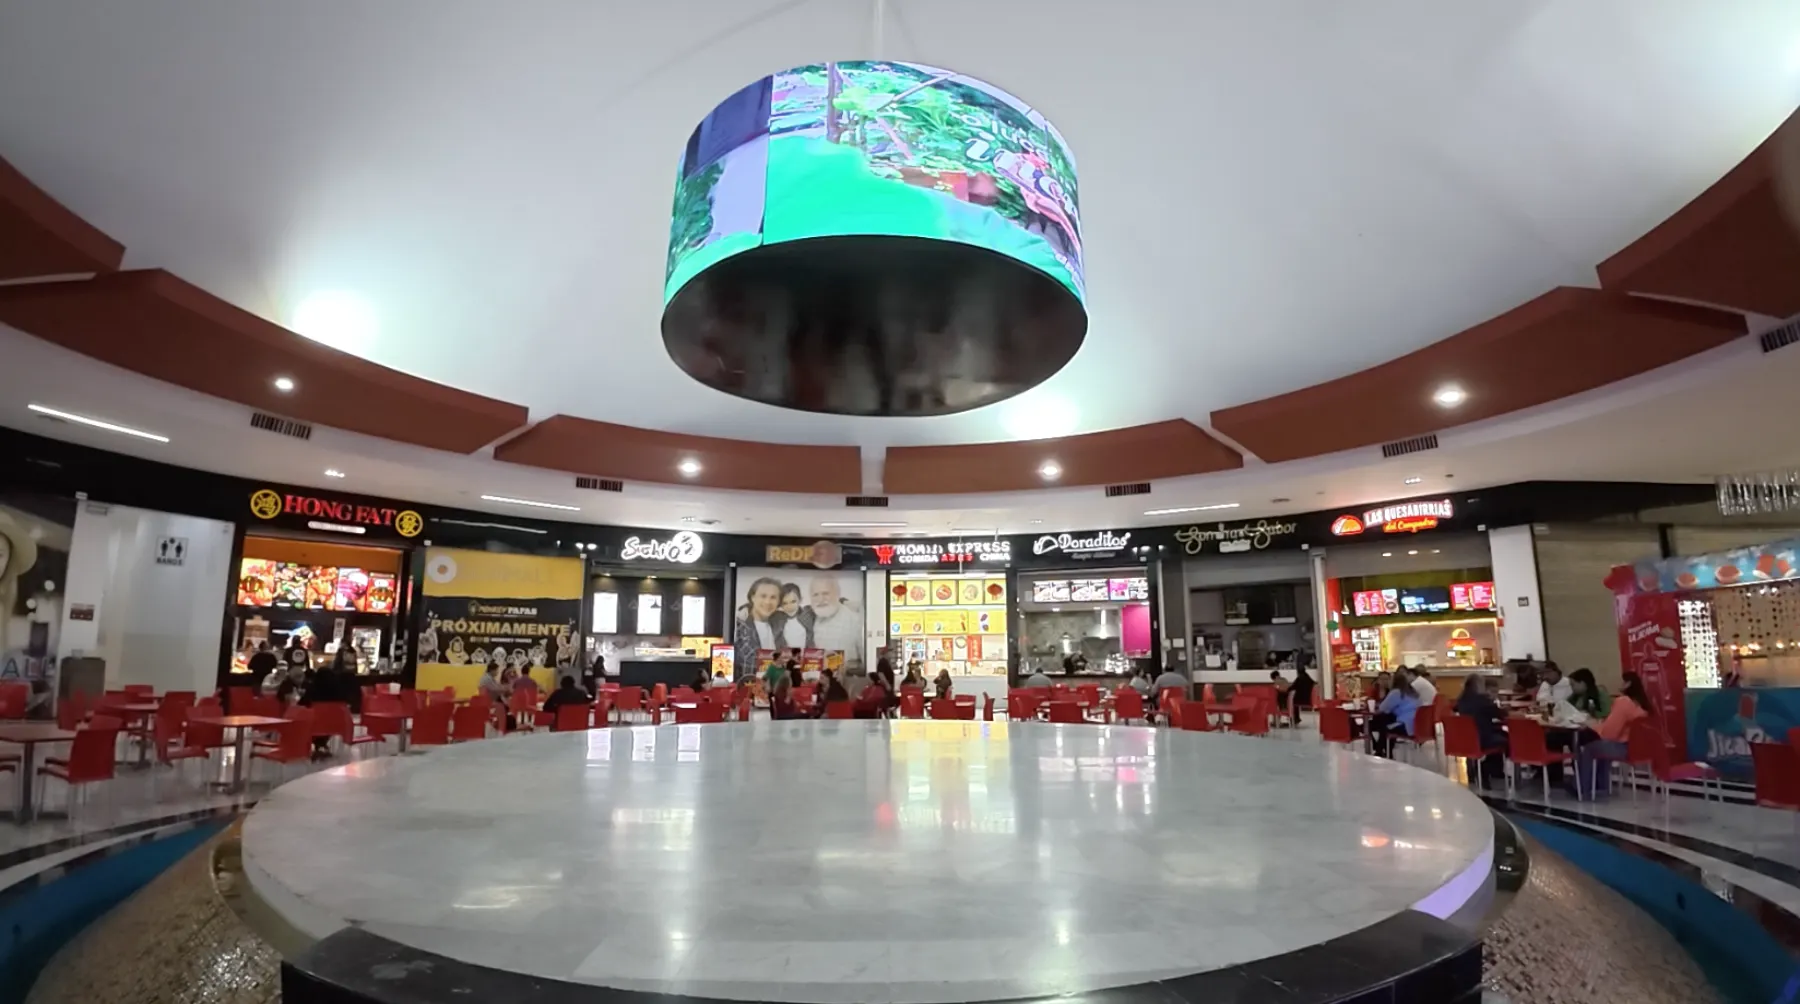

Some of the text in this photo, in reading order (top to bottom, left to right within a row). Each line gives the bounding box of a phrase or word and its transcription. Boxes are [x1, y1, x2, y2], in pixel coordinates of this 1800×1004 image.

[284, 494, 397, 526] HONG FAT
[948, 541, 1011, 553] EXPRESS
[1058, 531, 1130, 549] Doraditos
[431, 617, 570, 636] PRÓXIMAMENTE
